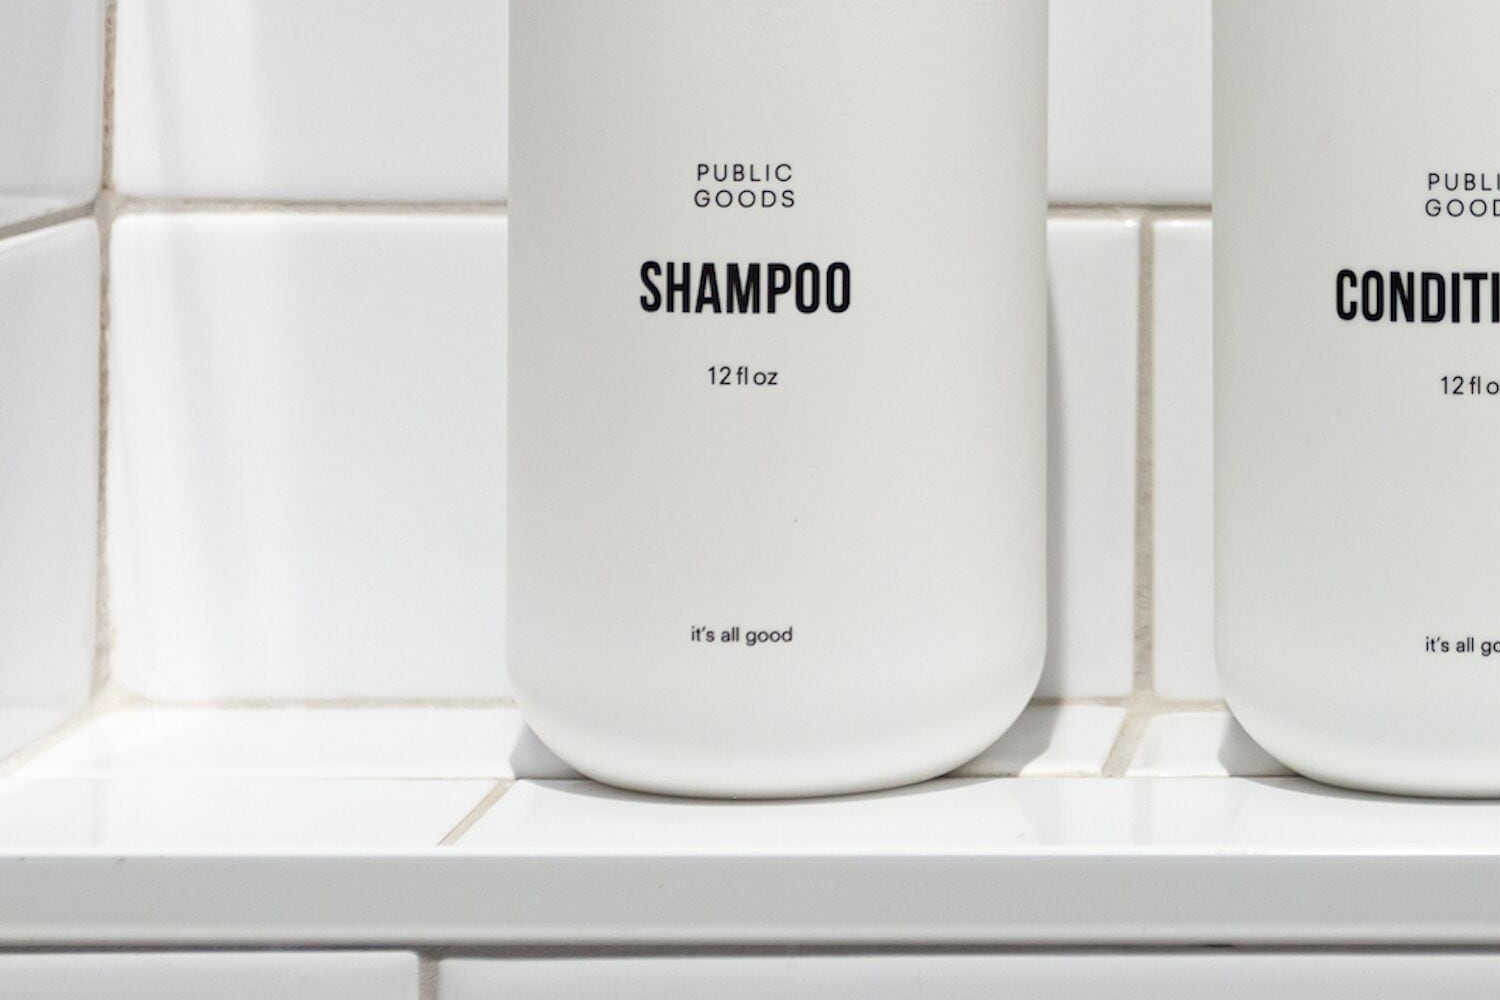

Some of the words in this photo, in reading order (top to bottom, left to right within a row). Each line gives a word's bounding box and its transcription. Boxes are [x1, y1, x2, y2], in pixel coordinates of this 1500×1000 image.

[697, 163, 792, 183] PUBLIC
[693, 188, 795, 209] GOODS
[639, 259, 851, 315] SHAMPOO
[708, 365, 732, 386] 12
[735, 365, 749, 386] fl
[752, 371, 779, 386] oz
[1440, 375, 1465, 396] 12
[1468, 375, 1481, 395] fl
[691, 625, 715, 643] it's
[720, 626, 740, 643] all
[745, 626, 793, 647] good
[1425, 635, 1450, 653] it's
[1455, 636, 1475, 654] all
